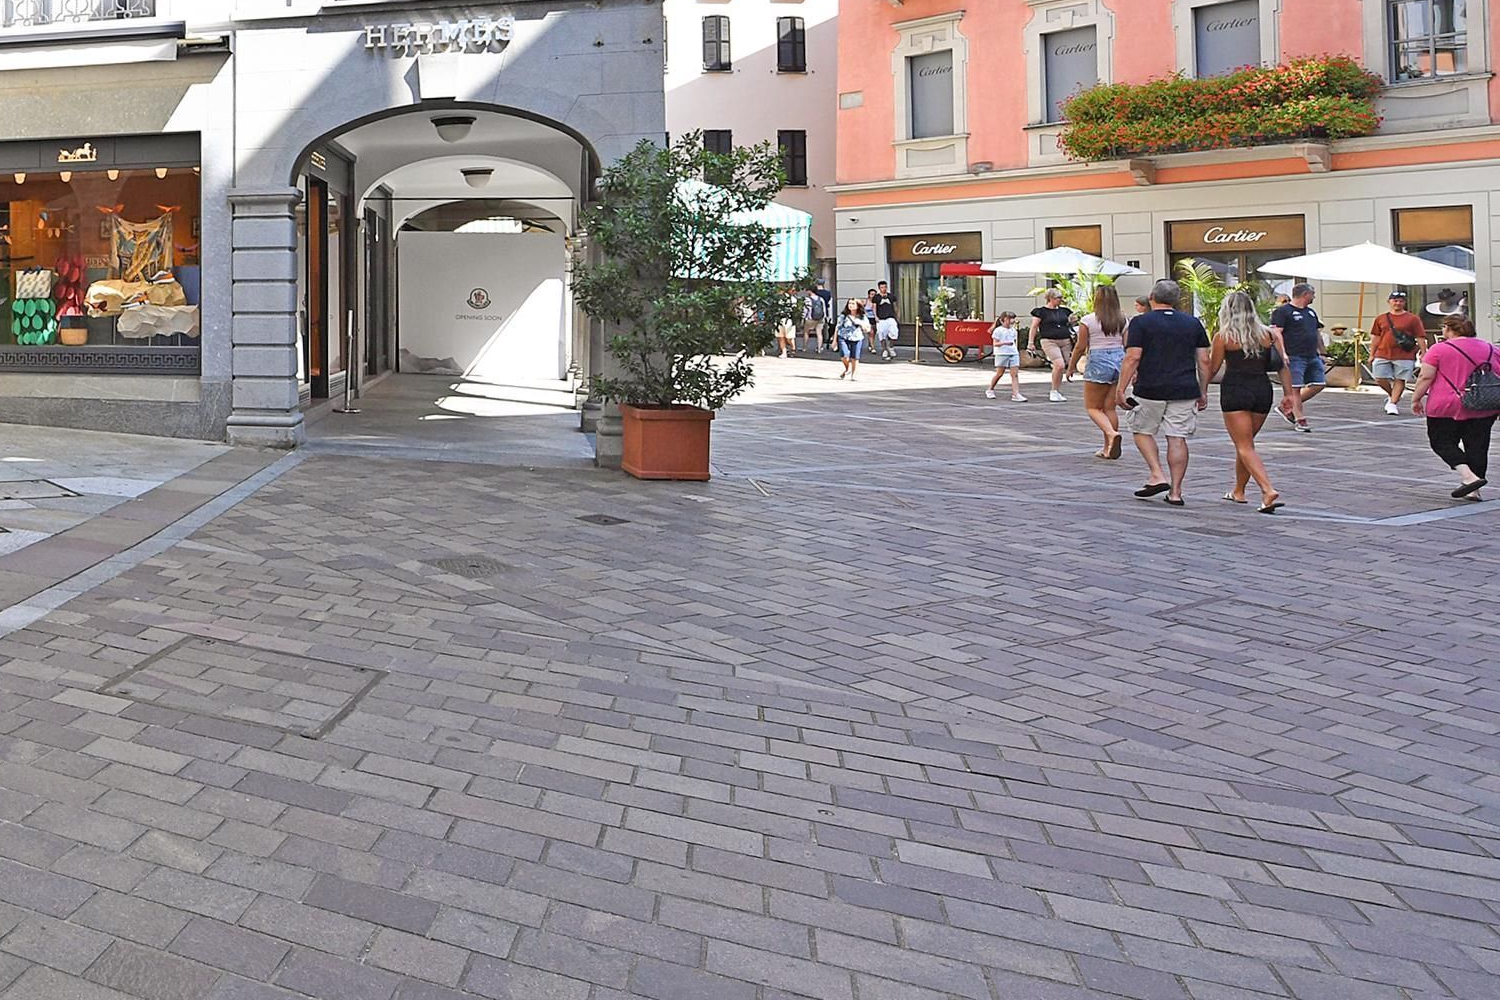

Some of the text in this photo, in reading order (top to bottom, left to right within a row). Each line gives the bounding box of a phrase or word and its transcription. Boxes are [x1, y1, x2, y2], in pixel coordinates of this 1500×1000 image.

[1206, 18, 1257, 32] Cartier
[1055, 43, 1097, 56] Cartier
[919, 66, 953, 77] Cartier
[1204, 226, 1267, 243] Cartier
[912, 240, 957, 255] Cartier
